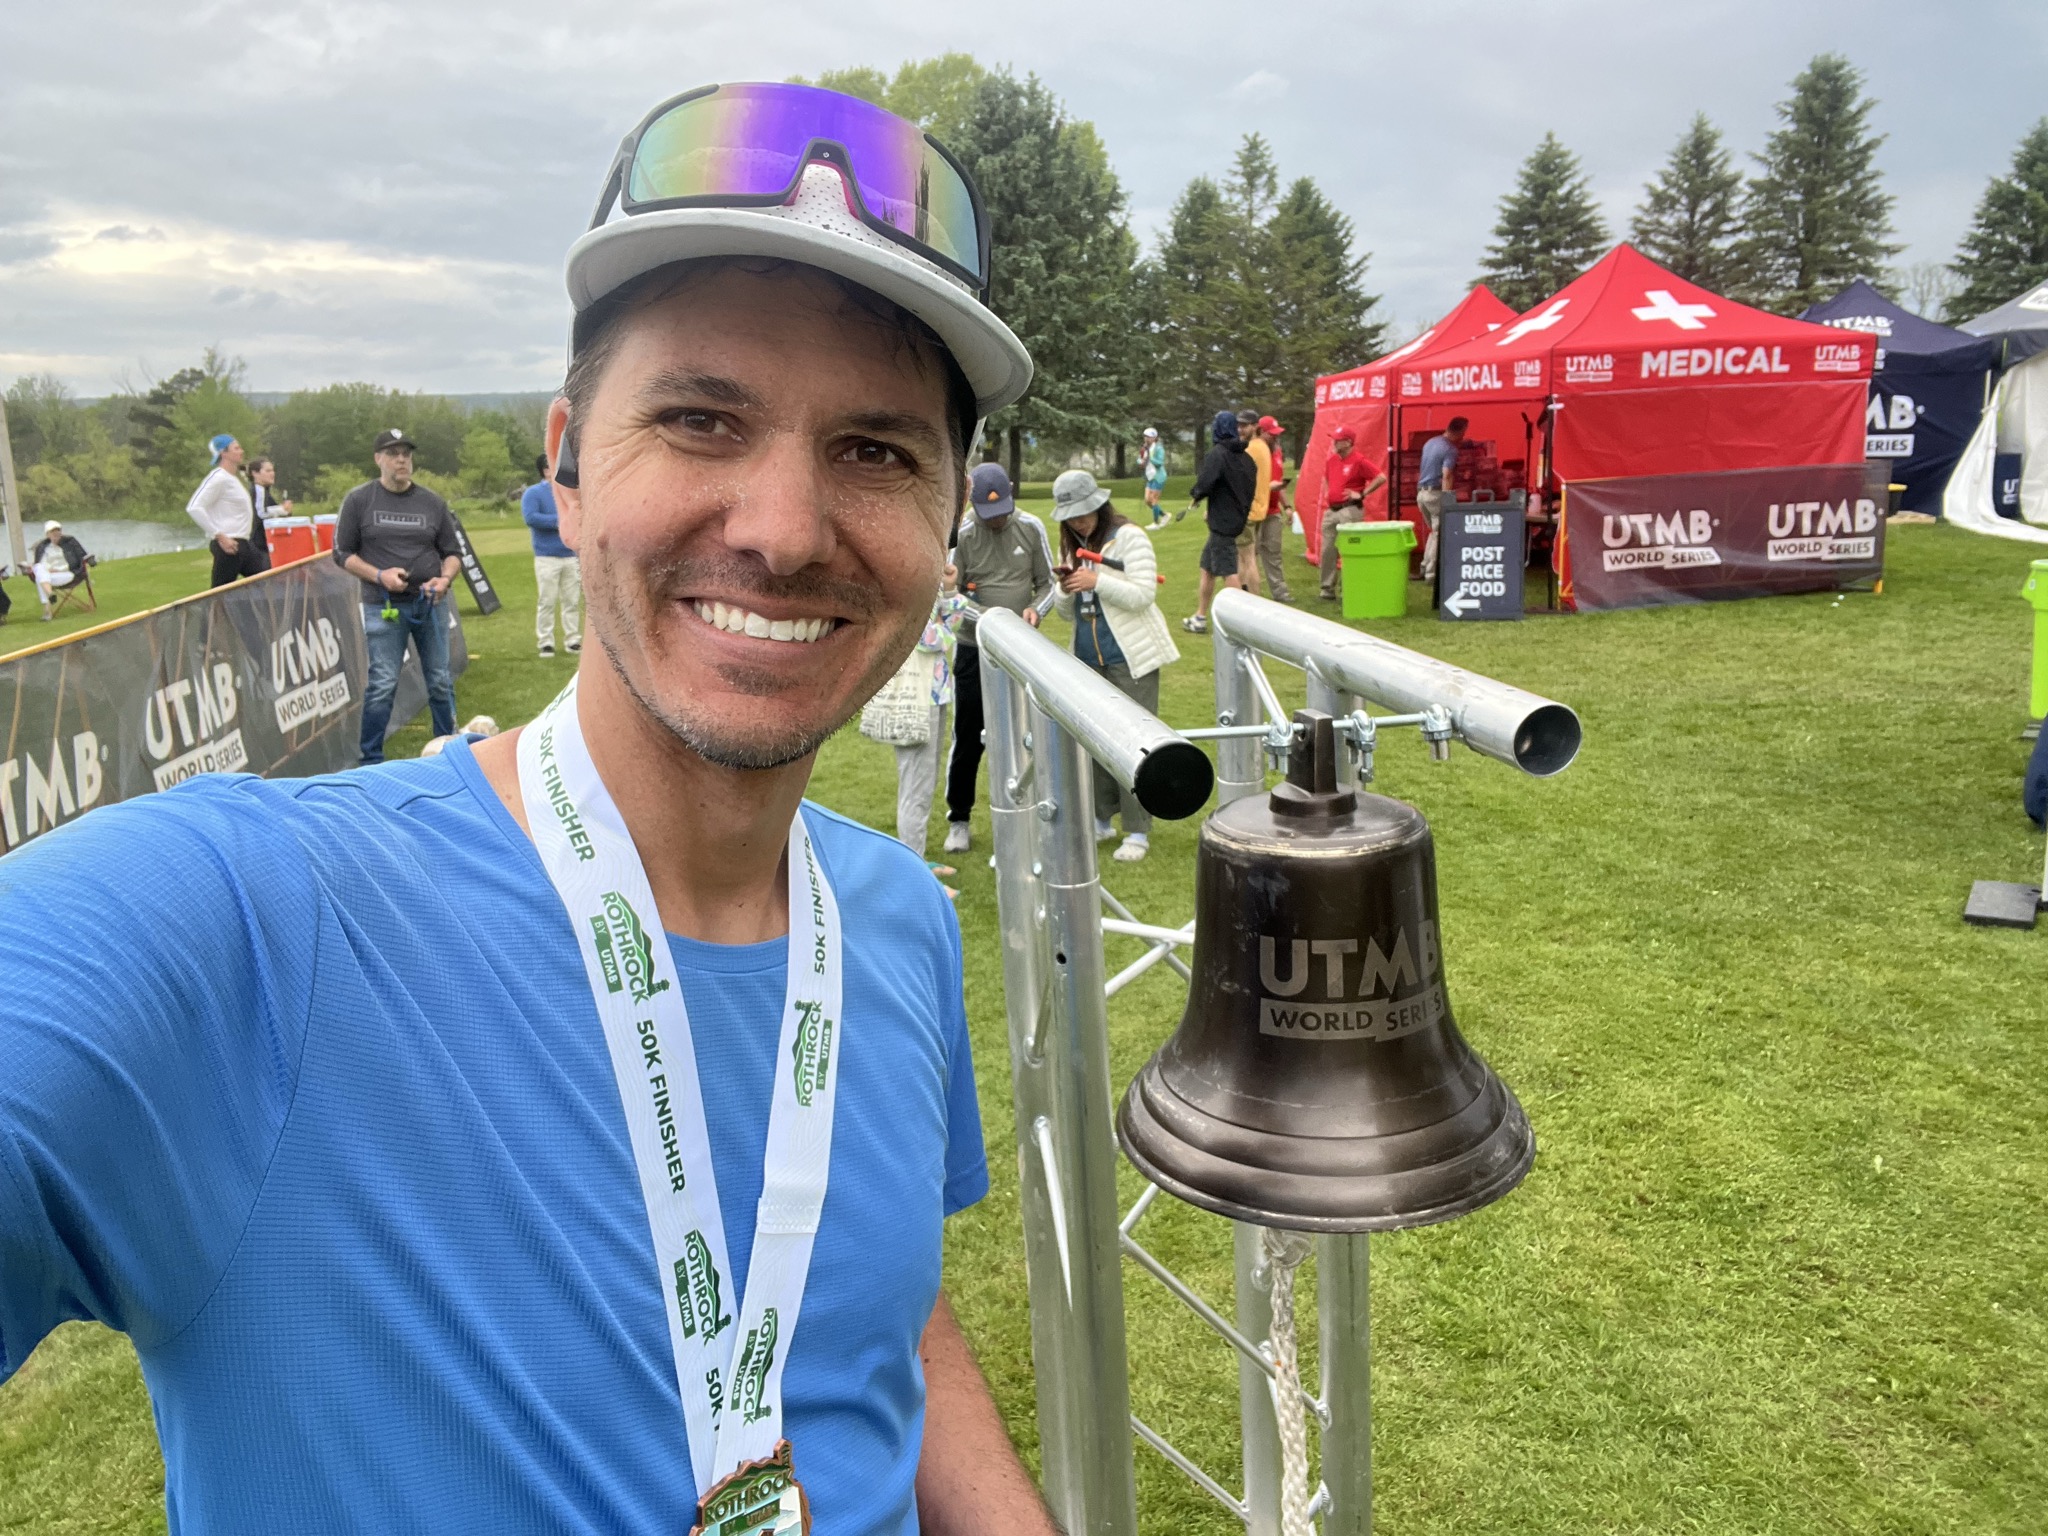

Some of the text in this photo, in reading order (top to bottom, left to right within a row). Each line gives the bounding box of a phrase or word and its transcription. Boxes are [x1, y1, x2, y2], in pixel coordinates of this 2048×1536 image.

[1514, 359, 1541, 376] UTMB
[1565, 354, 1614, 372] UTMB
[1641, 347, 1790, 379] MEDICAL
[1815, 345, 1861, 362] UTMB
[1329, 378, 1364, 401] MEDICAL
[1431, 364, 1502, 393] MEDICAL
[1464, 514, 1503, 525] UTMB
[1602, 509, 1713, 548] UTMB
[1767, 498, 1878, 538] UTMB
[1461, 546, 1505, 562] POST
[1608, 550, 1665, 566] WORLD
[1773, 540, 1871, 556] WORLD SERIES
[1459, 581, 1506, 597] FOOD
[1461, 564, 1504, 579] RACE
[271, 617, 340, 694] UTMB
[145, 662, 238, 760] UTMB
[278, 691, 317, 725] WORLD
[540, 726, 596, 863] 50K FINISHER
[804, 836, 826, 975] 50K FINISHER
[594, 920, 618, 984] BY UTMB
[600, 891, 650, 1006] ROTHROCK
[1260, 919, 1438, 998] UTMB
[1270, 991, 1442, 1031] WORLD SERIS
[800, 1000, 823, 1107] ROTHROCK
[817, 1028, 832, 1085] BY UTMB
[637, 1019, 686, 1194] 50K FINISHER
[678, 1265, 693, 1329] BY UTMB
[684, 1229, 716, 1348] ROTHROCK
[732, 1335, 756, 1400] BY UTMB
[743, 1307, 775, 1427] ROTHROCK
[706, 1367, 723, 1418] 50K
[704, 1469, 794, 1525] ROTHROCK
